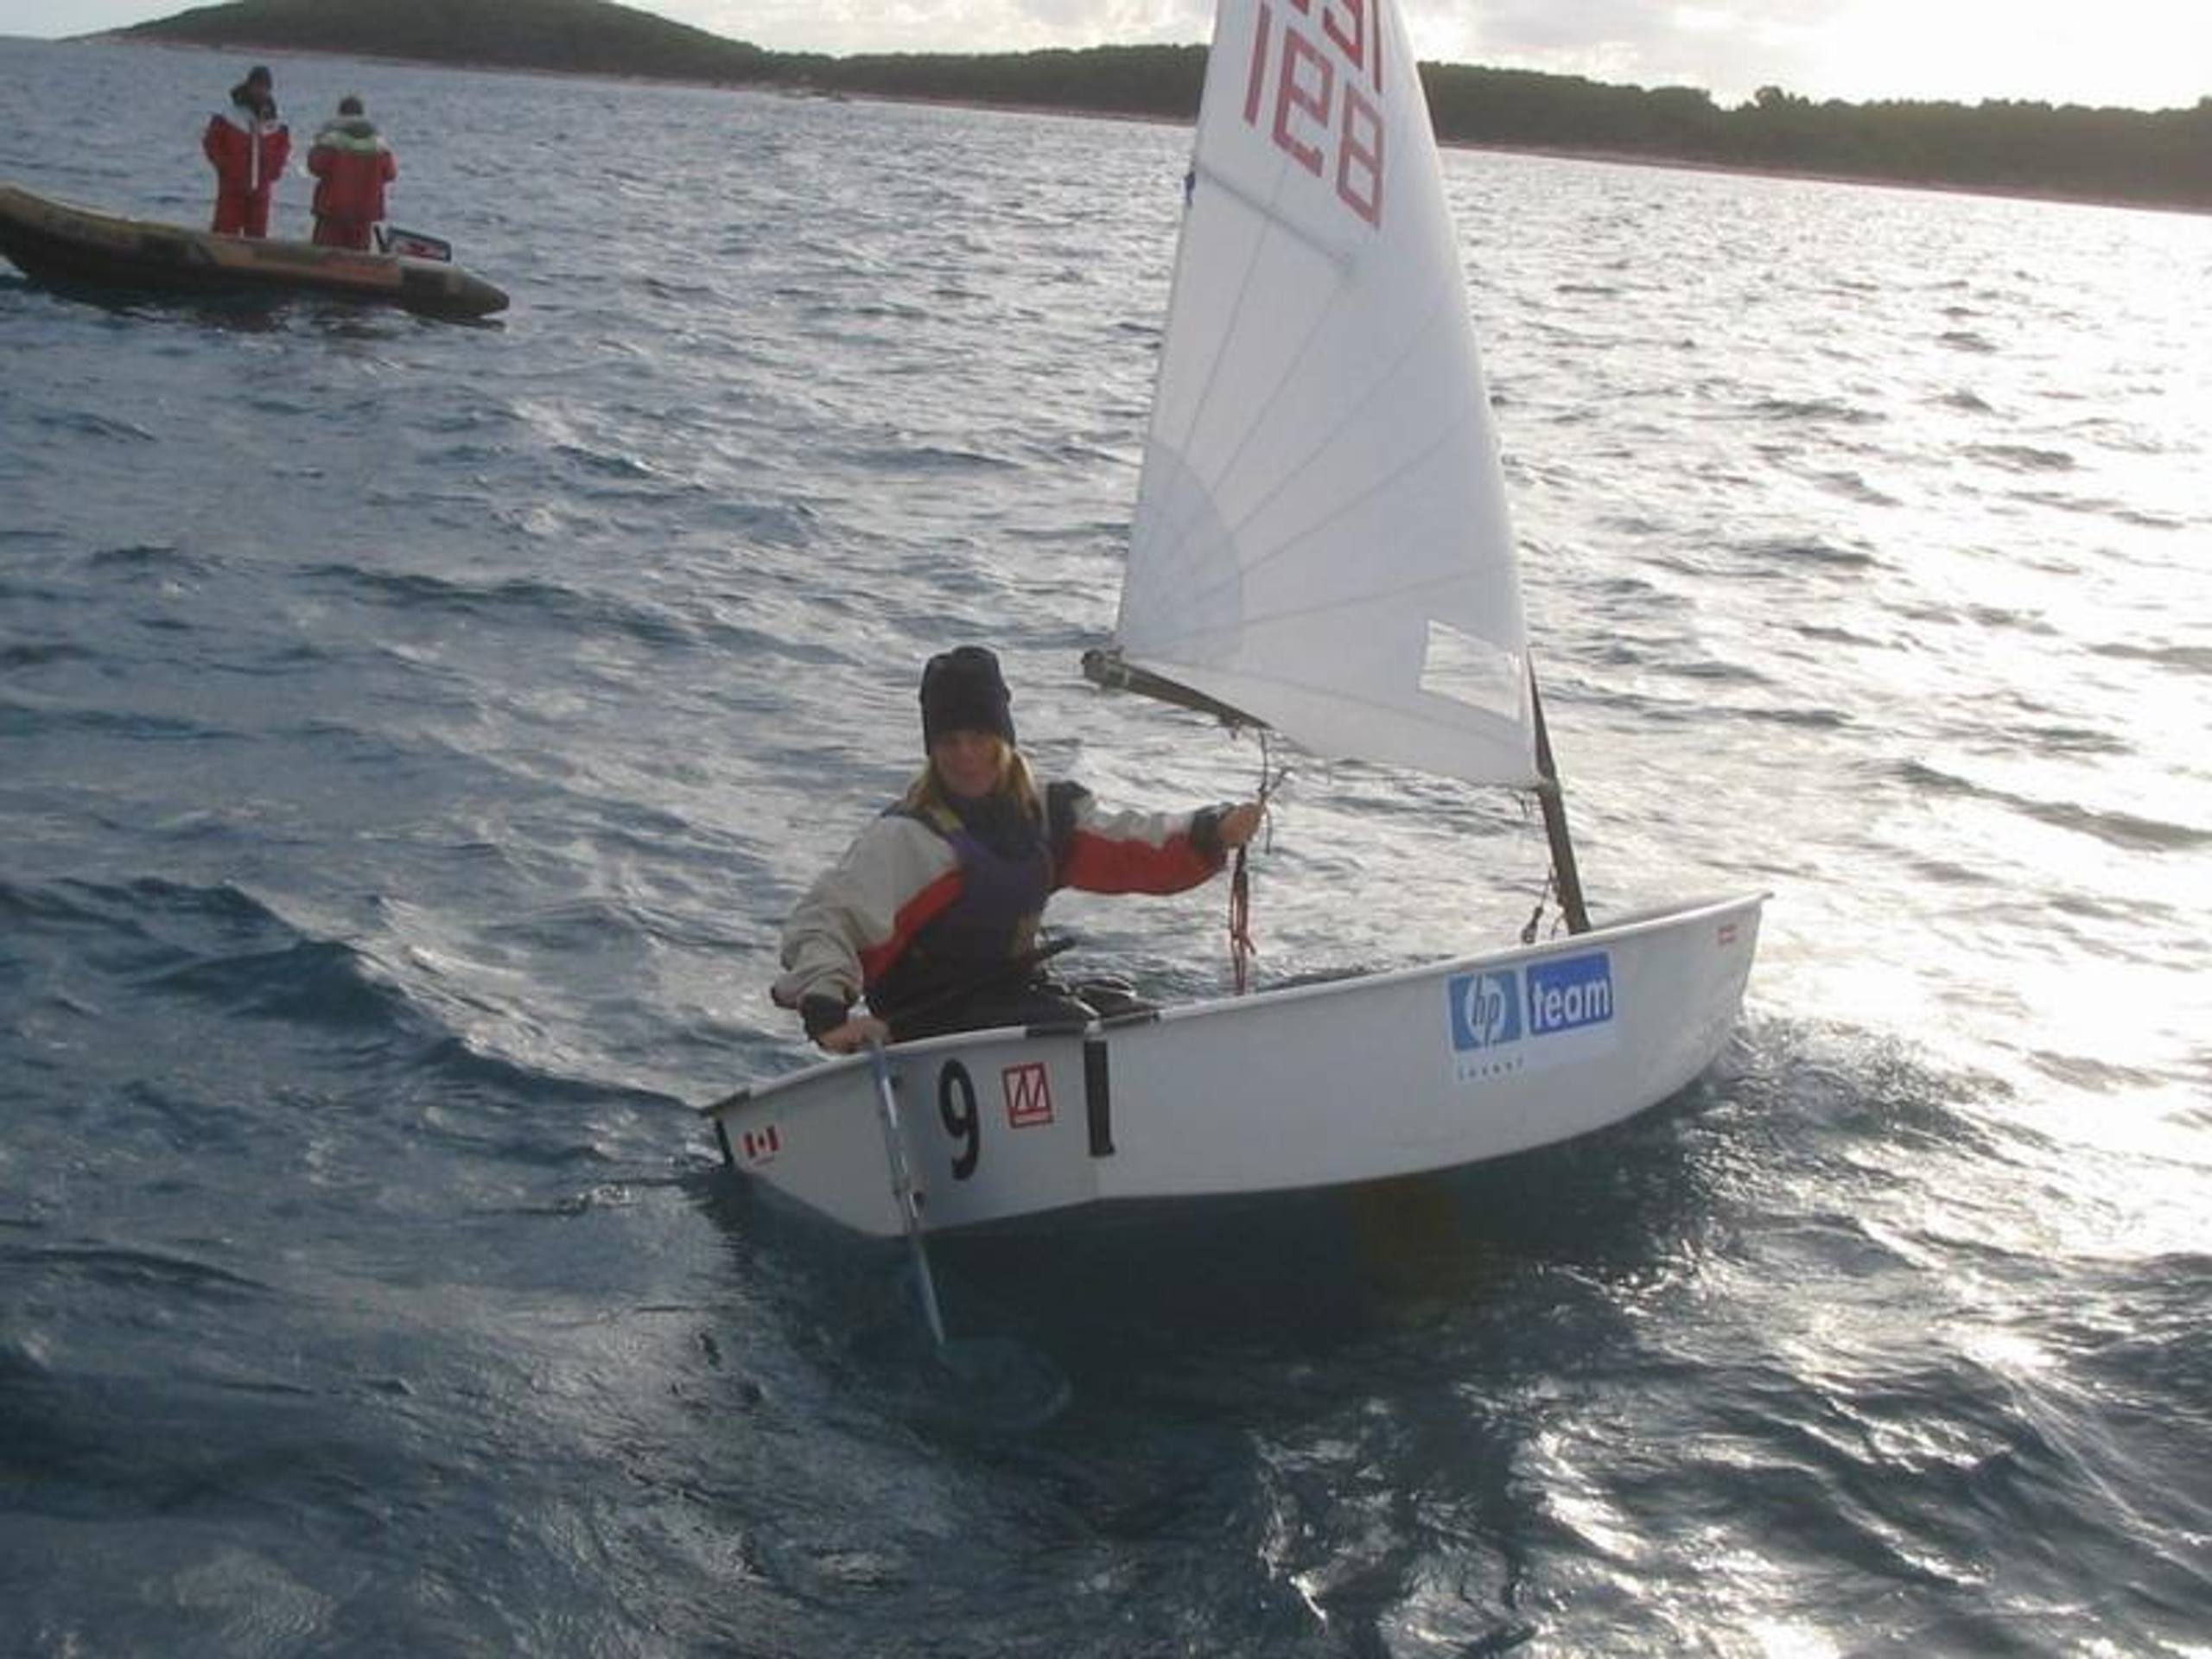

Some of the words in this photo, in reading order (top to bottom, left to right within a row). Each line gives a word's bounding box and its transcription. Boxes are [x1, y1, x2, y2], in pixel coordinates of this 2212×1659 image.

[1471, 974, 1501, 1048] hp
[1533, 979, 1611, 1030] team
[938, 1058, 979, 1180] 9
